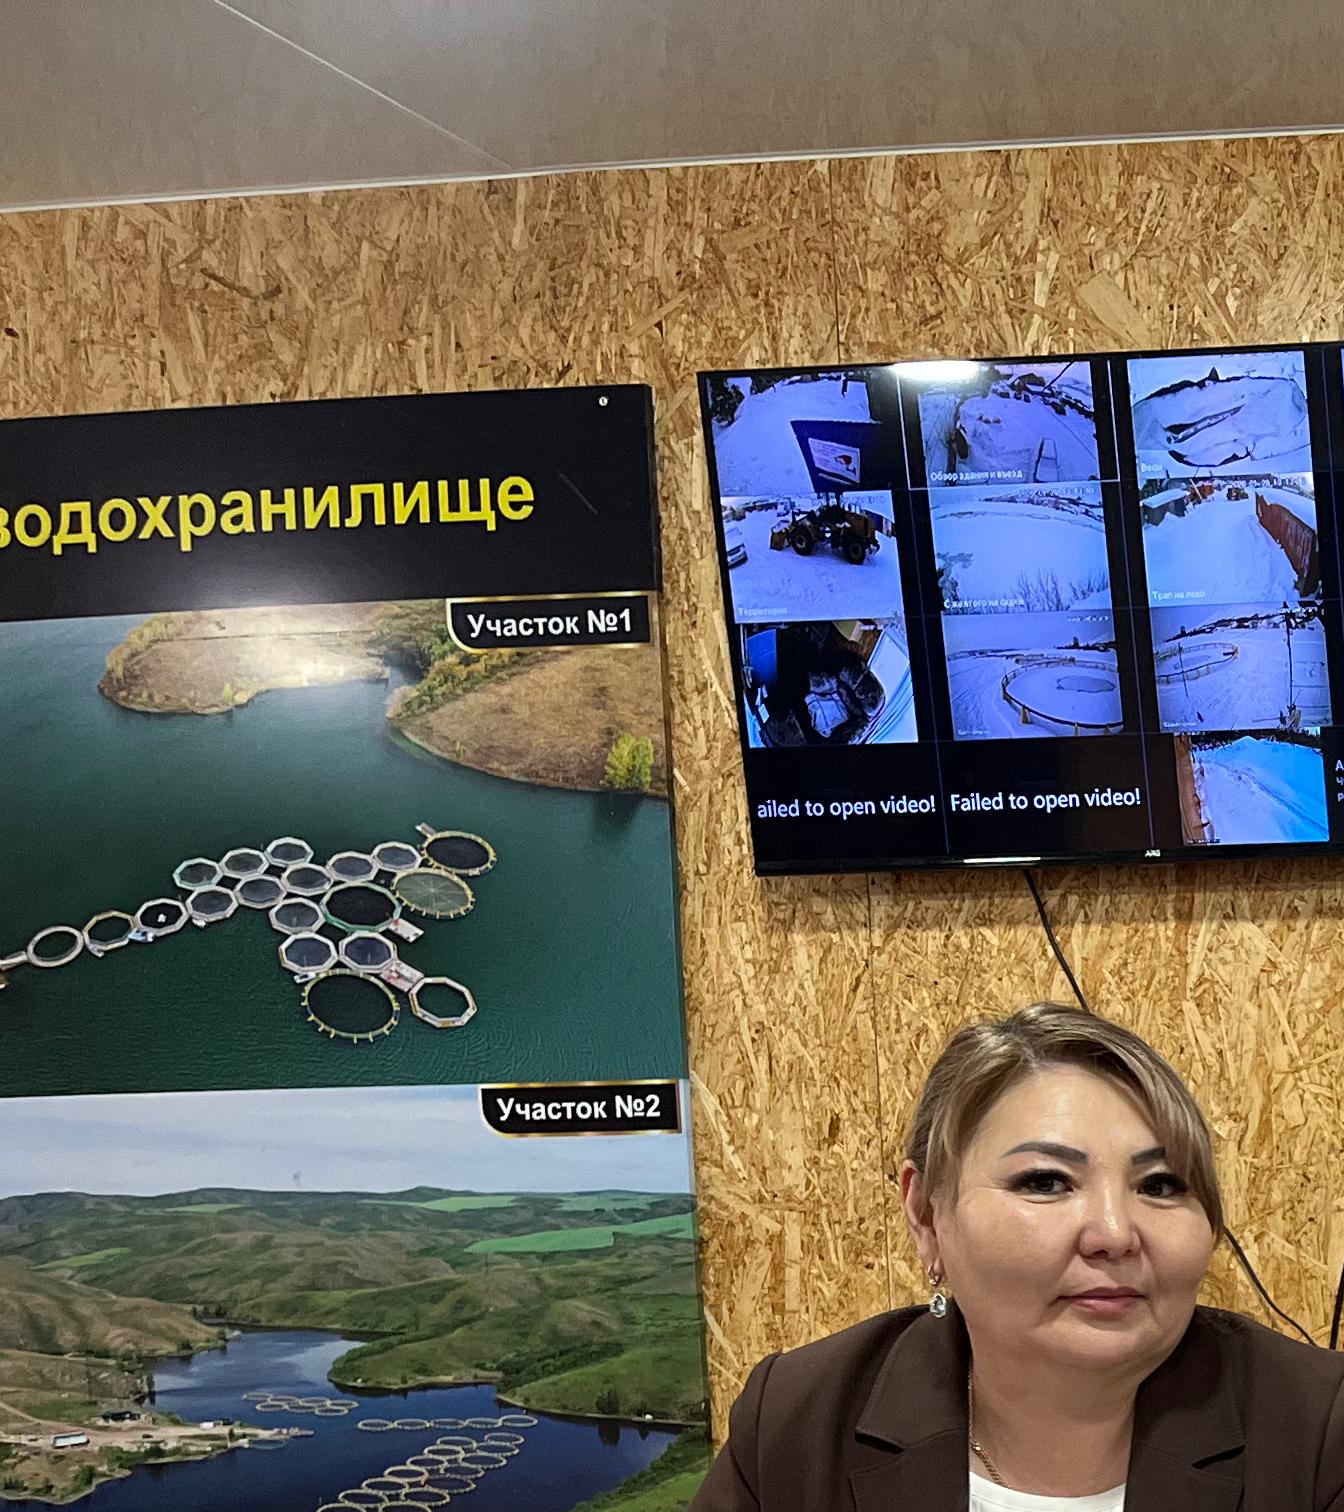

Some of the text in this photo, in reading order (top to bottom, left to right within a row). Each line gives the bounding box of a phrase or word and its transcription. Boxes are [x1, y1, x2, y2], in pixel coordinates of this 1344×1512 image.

[930, 470, 959, 481] Обзор
[467, 607, 632, 638] Участок №1
[804, 799, 825, 817] to
[829, 799, 876, 821] open
[880, 794, 937, 815] video!
[950, 787, 1142, 815] Failed to open video!
[496, 1093, 661, 1122] Участок №2
